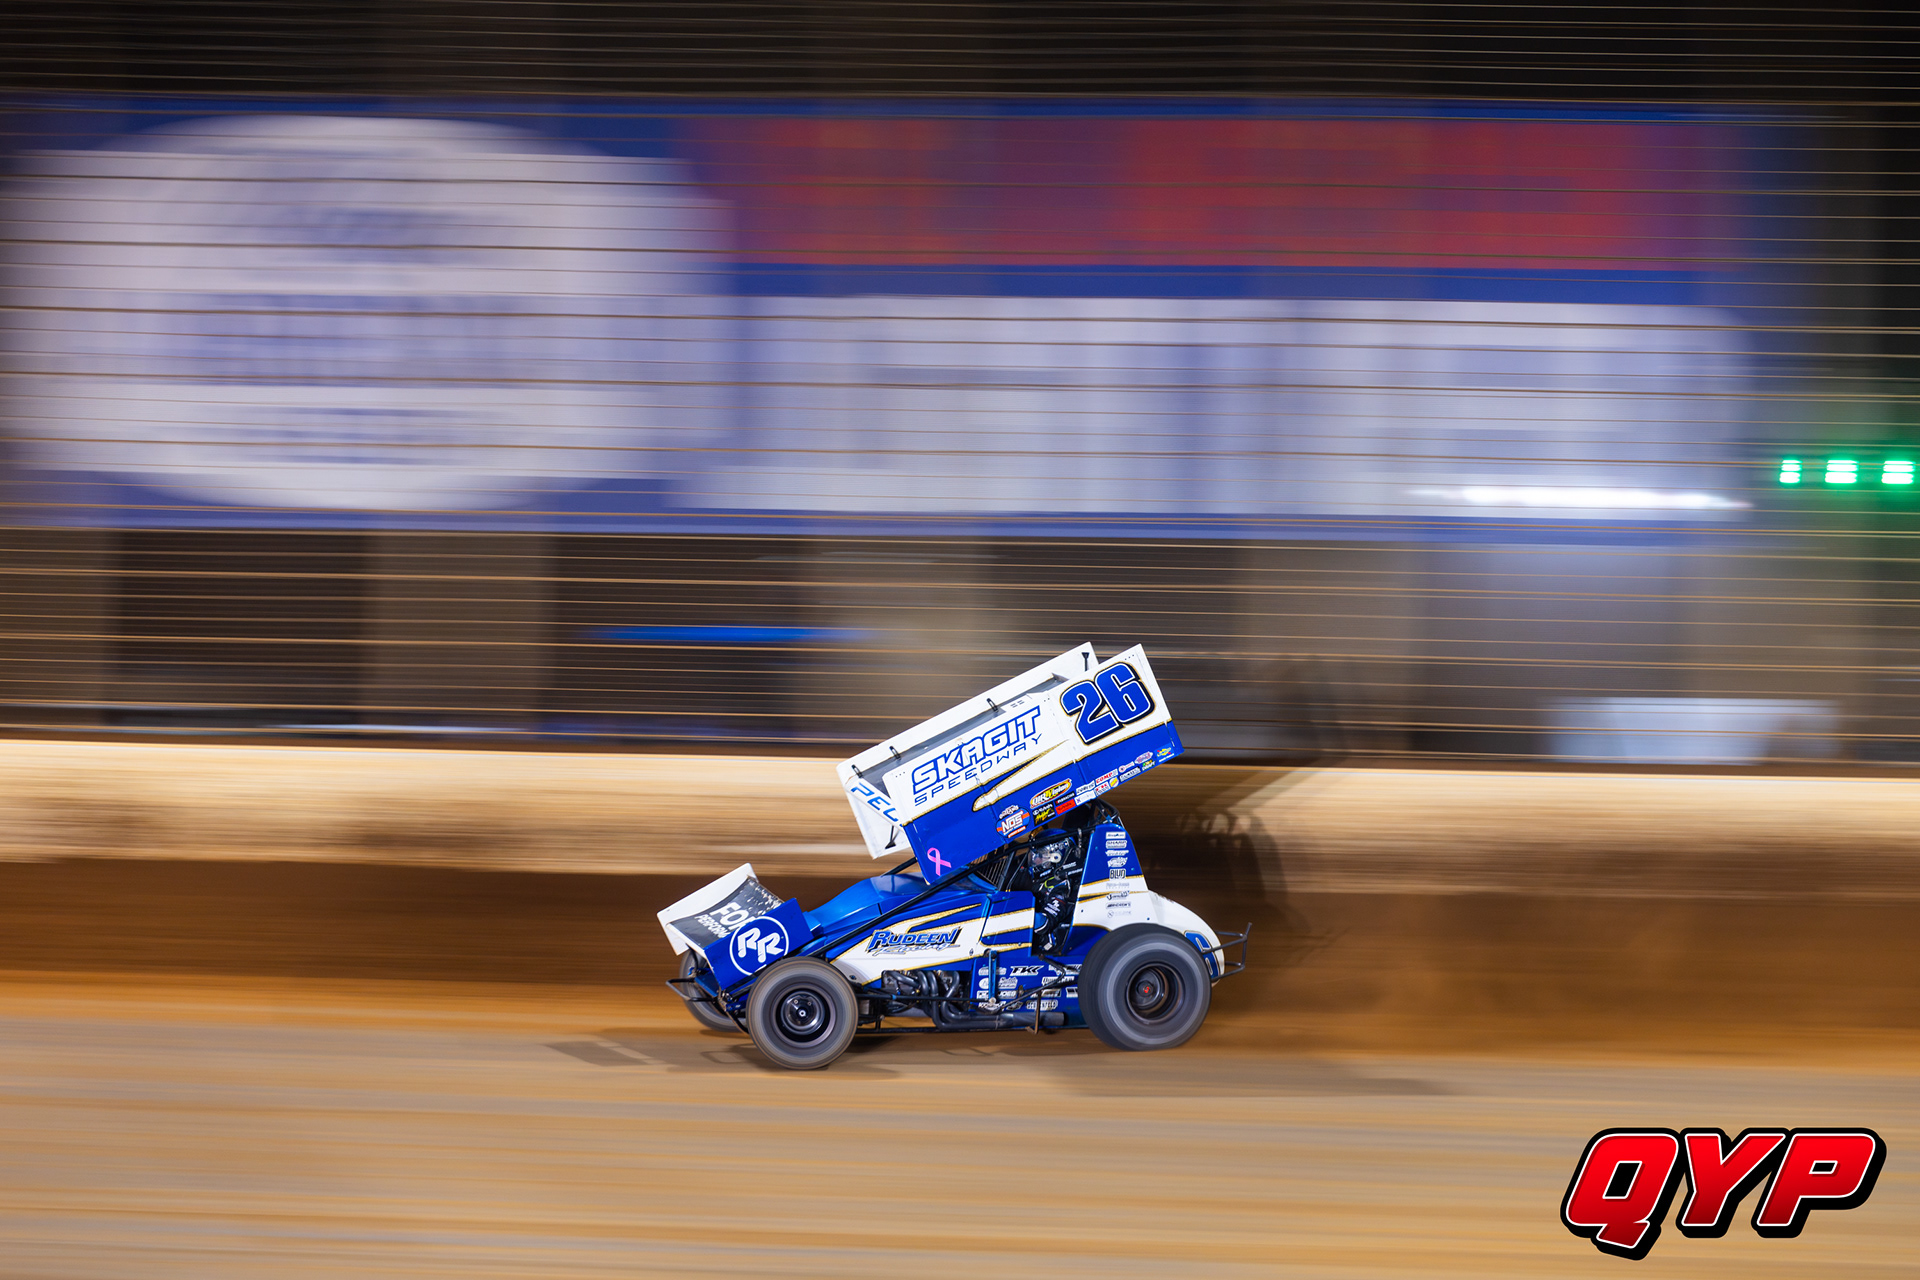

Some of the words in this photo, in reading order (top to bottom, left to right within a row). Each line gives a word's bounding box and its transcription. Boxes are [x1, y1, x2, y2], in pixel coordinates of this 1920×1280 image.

[1059, 661, 1156, 746] 26
[910, 704, 1042, 796] SKAGIT
[914, 732, 1043, 807] SPEEDWAY
[737, 927, 784, 963] RR
[865, 926, 962, 953] RUDEEN
